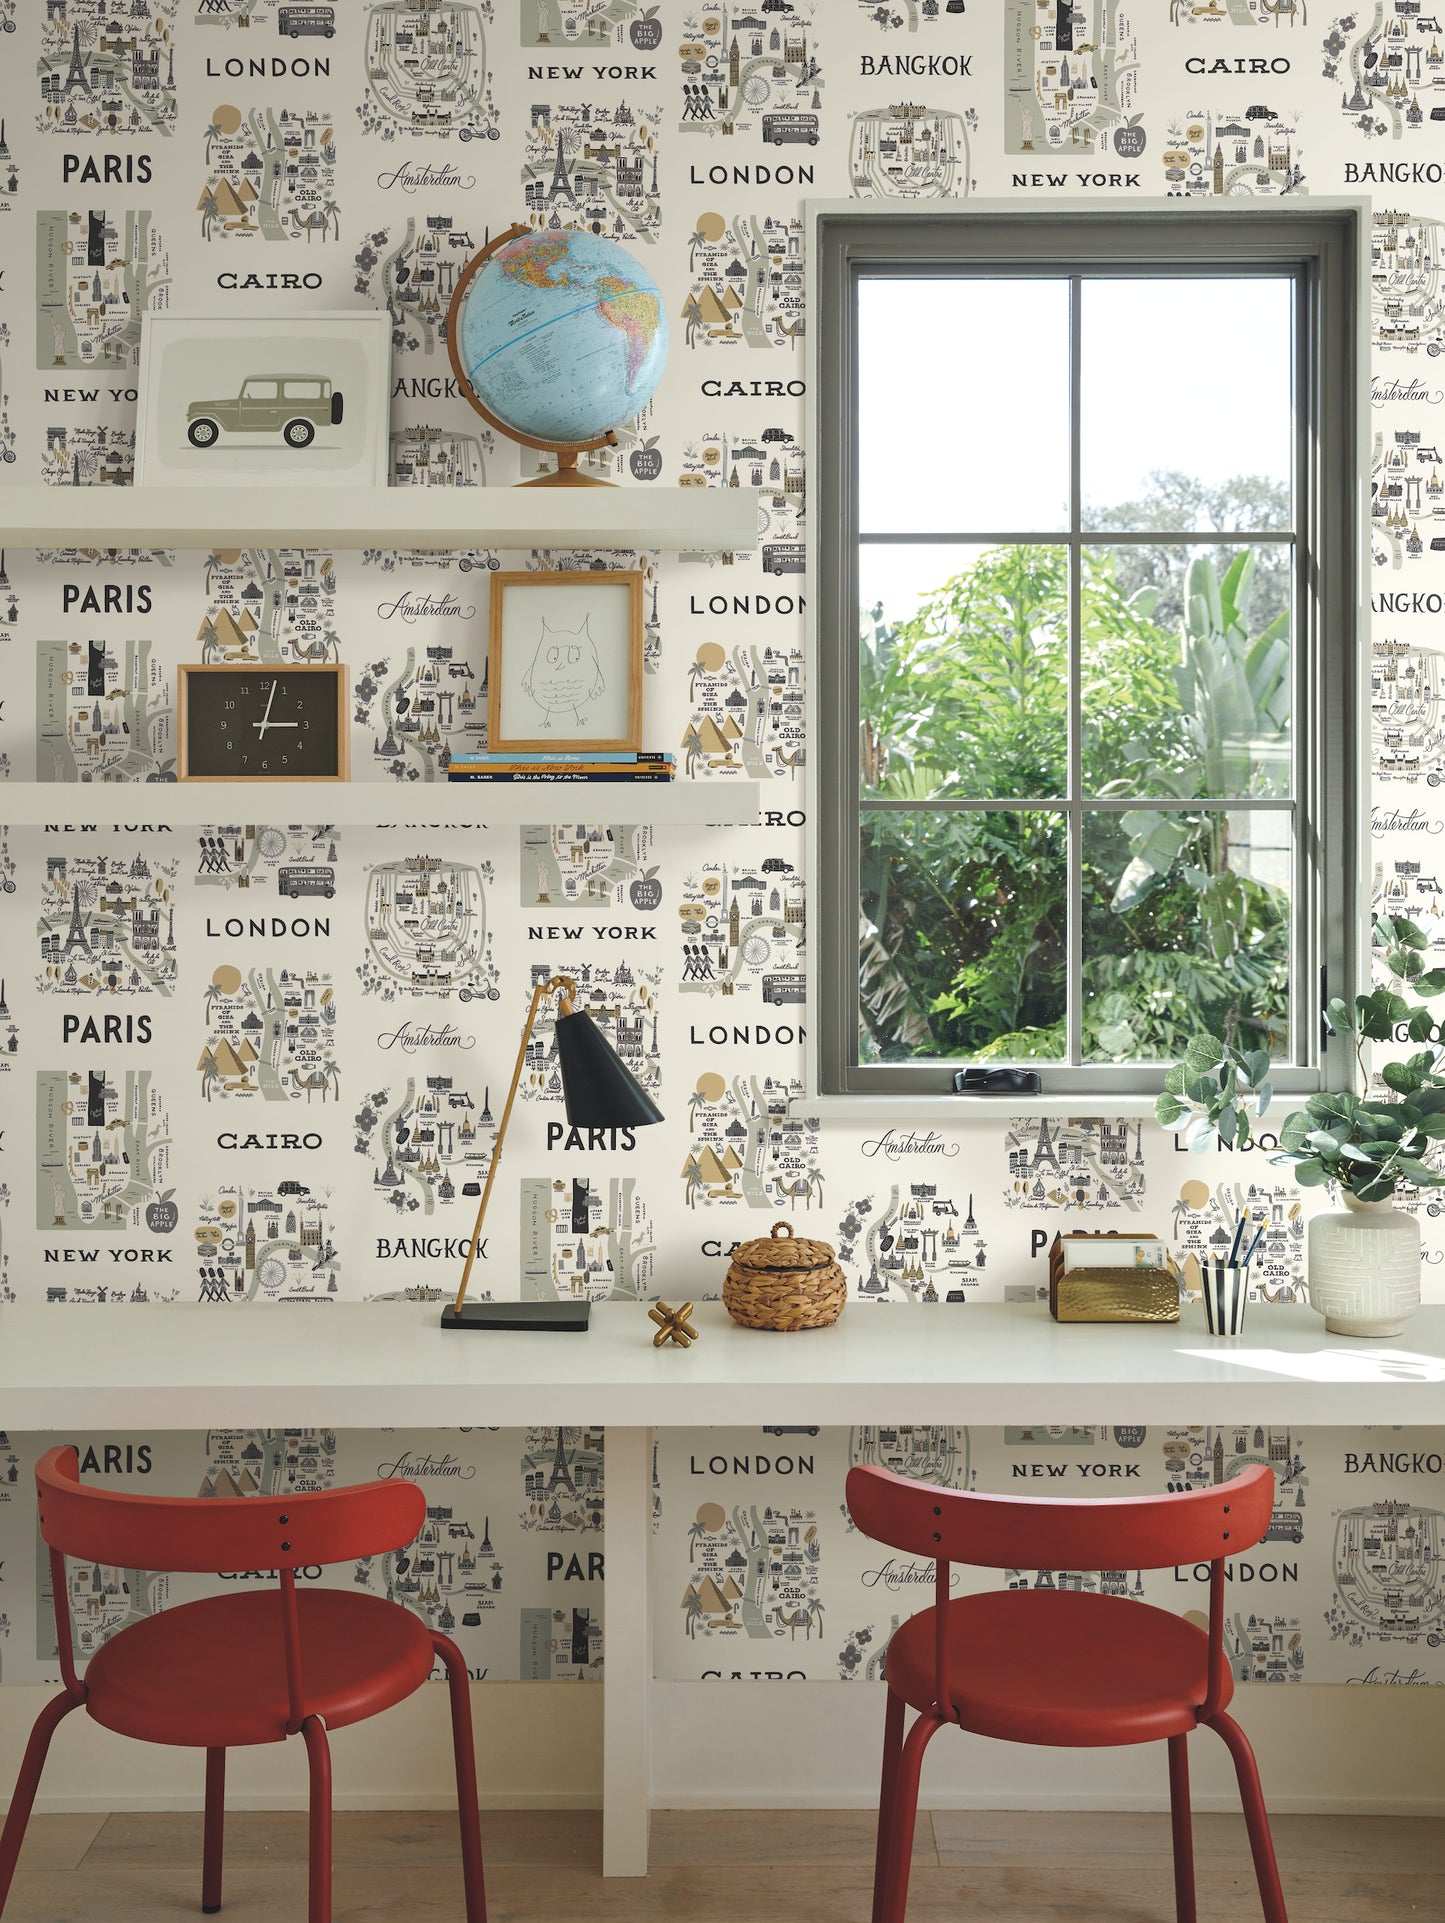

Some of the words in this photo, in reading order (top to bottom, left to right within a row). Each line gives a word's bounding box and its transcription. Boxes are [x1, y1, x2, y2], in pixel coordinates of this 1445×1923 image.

[637, 30, 654, 38] BIG
[207, 58, 330, 76] LONDON
[860, 55, 972, 76] BANGKOK
[1185, 58, 1291, 74] CAIRO
[528, 67, 583, 79] NEW
[592, 66, 657, 79] YORK
[1121, 137, 1138, 145] BIG
[64, 155, 151, 183] PARIS
[691, 166, 814, 184] LONDON
[1344, 163, 1445, 183] BANGKO
[377, 162, 475, 194] Amsterdam
[1012, 174, 1067, 187] NEW
[1076, 174, 1141, 187] YORK
[218, 273, 323, 290] CAIRO
[44, 390, 99, 402] NEW
[107, 389, 138, 402] YO
[702, 381, 806, 397] CAIRO
[637, 460, 654, 468] BIG
[64, 585, 151, 613] PARIS
[377, 592, 475, 623] Amsterdam
[240, 686, 250, 695] 11
[260, 681, 270, 690] 12
[282, 686, 288, 695] 1
[224, 700, 235, 709] 10
[297, 700, 303, 709] 2
[220, 720, 227, 730] 9
[303, 721, 310, 730] 3
[226, 741, 233, 750] 8
[297, 741, 303, 750] 4
[242, 755, 248, 764] 7
[261, 760, 268, 769] 6
[281, 755, 288, 764] 5
[637, 890, 654, 898] BIG
[207, 918, 330, 937] LONDON
[528, 927, 584, 939] NEW
[592, 926, 657, 939] YORK
[64, 1015, 151, 1043] PARIS
[377, 1022, 475, 1053] Amsterdam
[218, 1133, 323, 1150] CAIRO
[862, 1129, 959, 1161] Amsterdam
[153, 1212, 170, 1220] BIG
[377, 1238, 489, 1258] BANGKOK
[45, 1250, 100, 1262] NEW
[107, 1249, 172, 1262] YORK
[1121, 1427, 1138, 1435] BIG
[80, 1445, 151, 1473] ARIS
[691, 1456, 814, 1474] LONDON
[1344, 1453, 1445, 1473] BANGKO
[377, 1451, 476, 1483] Amsterdam
[1012, 1465, 1067, 1477] NEW
[1076, 1464, 1141, 1477] YORK
[548, 1552, 603, 1580] PAR
[862, 1559, 960, 1591] Amsterda
